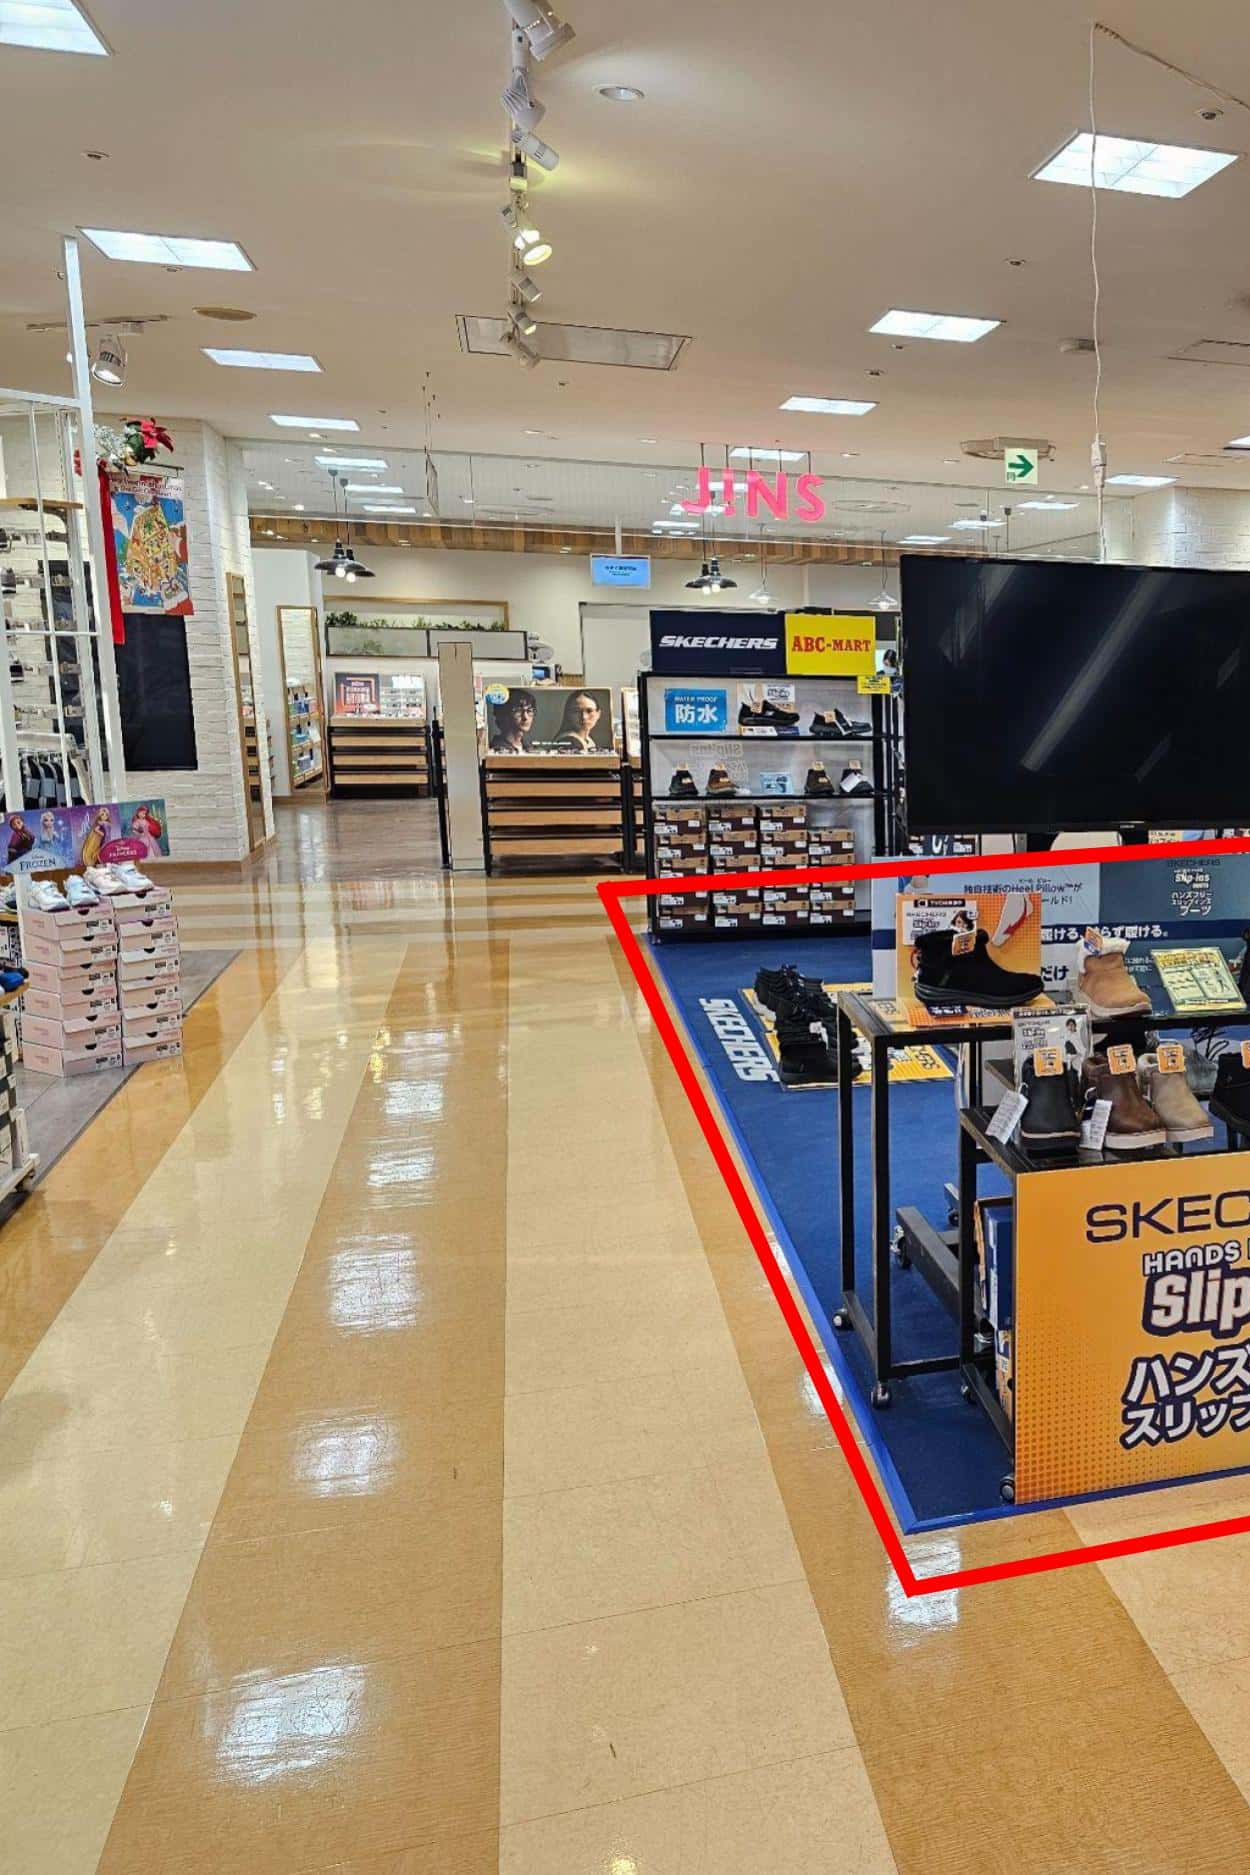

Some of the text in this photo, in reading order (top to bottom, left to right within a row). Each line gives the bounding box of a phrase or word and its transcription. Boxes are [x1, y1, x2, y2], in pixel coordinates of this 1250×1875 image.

[681, 465, 827, 522] JINS
[659, 635, 779, 650] SKECHERS
[792, 635, 871, 653] ABC-MART
[675, 704, 718, 724] 防水
[20, 858, 56, 871] FROZEN
[698, 998, 780, 1083] SKECHERS
[1143, 1241, 1240, 1275] HANDS
